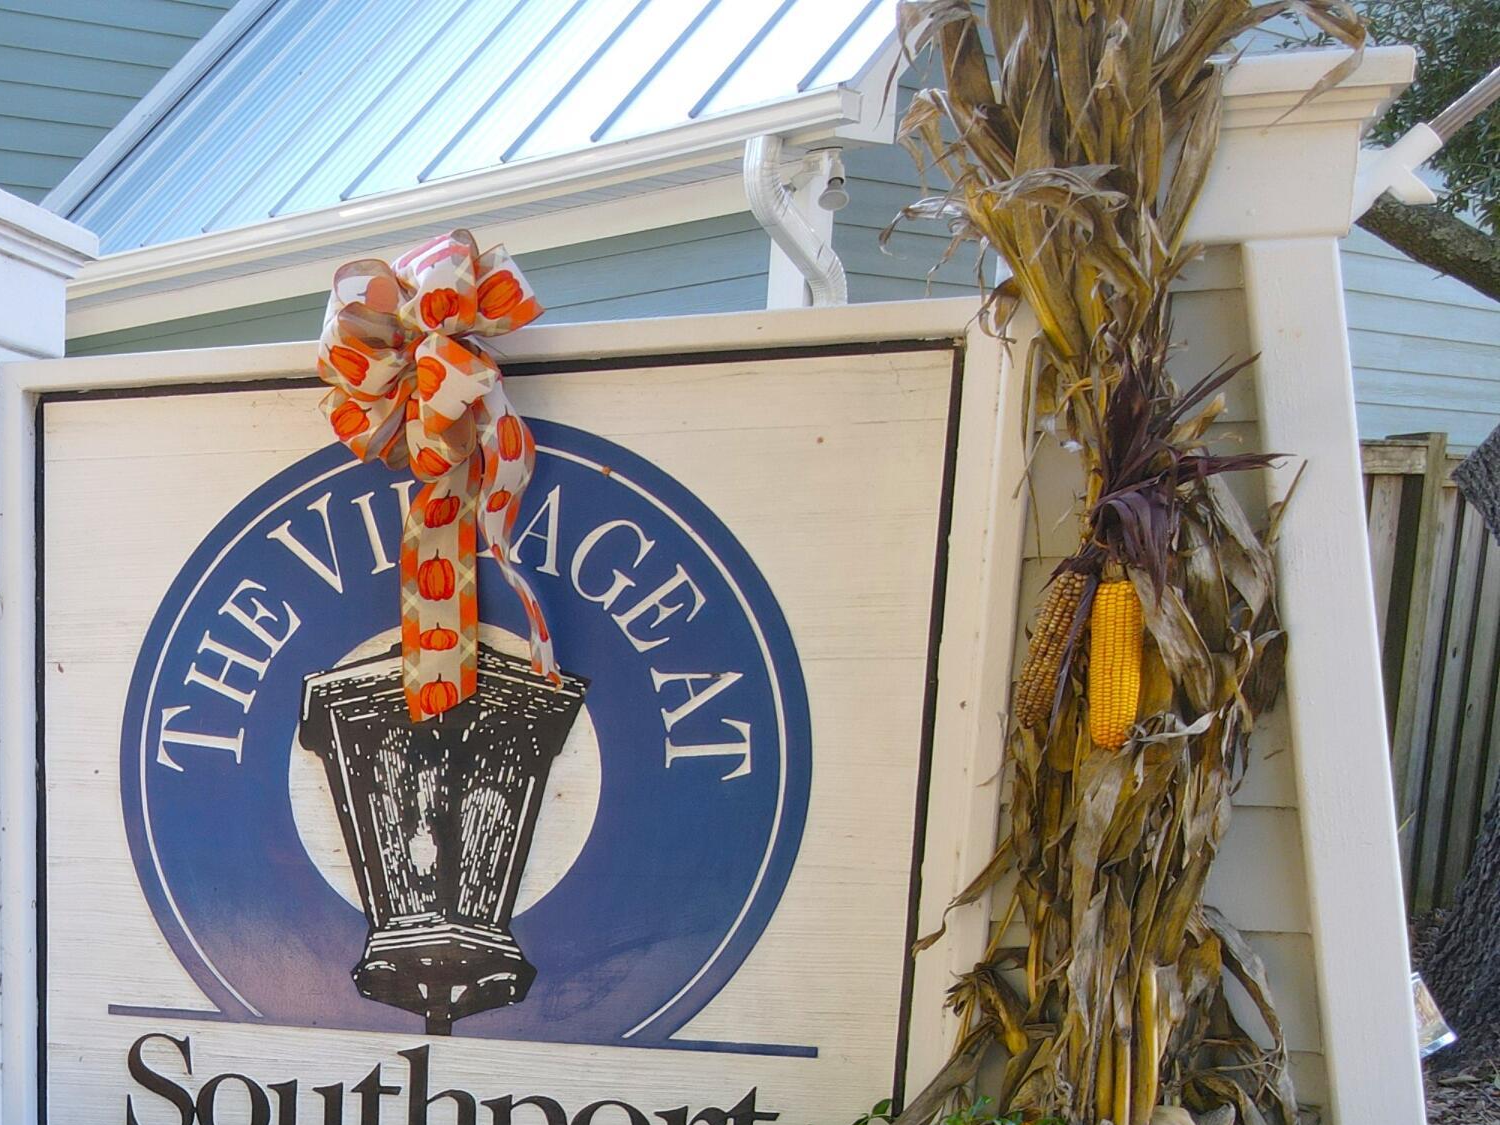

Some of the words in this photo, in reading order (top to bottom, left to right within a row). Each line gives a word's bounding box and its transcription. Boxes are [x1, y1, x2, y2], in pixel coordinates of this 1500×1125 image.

[156, 577, 301, 772] THE
[266, 479, 707, 653] VIAGE
[649, 665, 753, 781] AT
